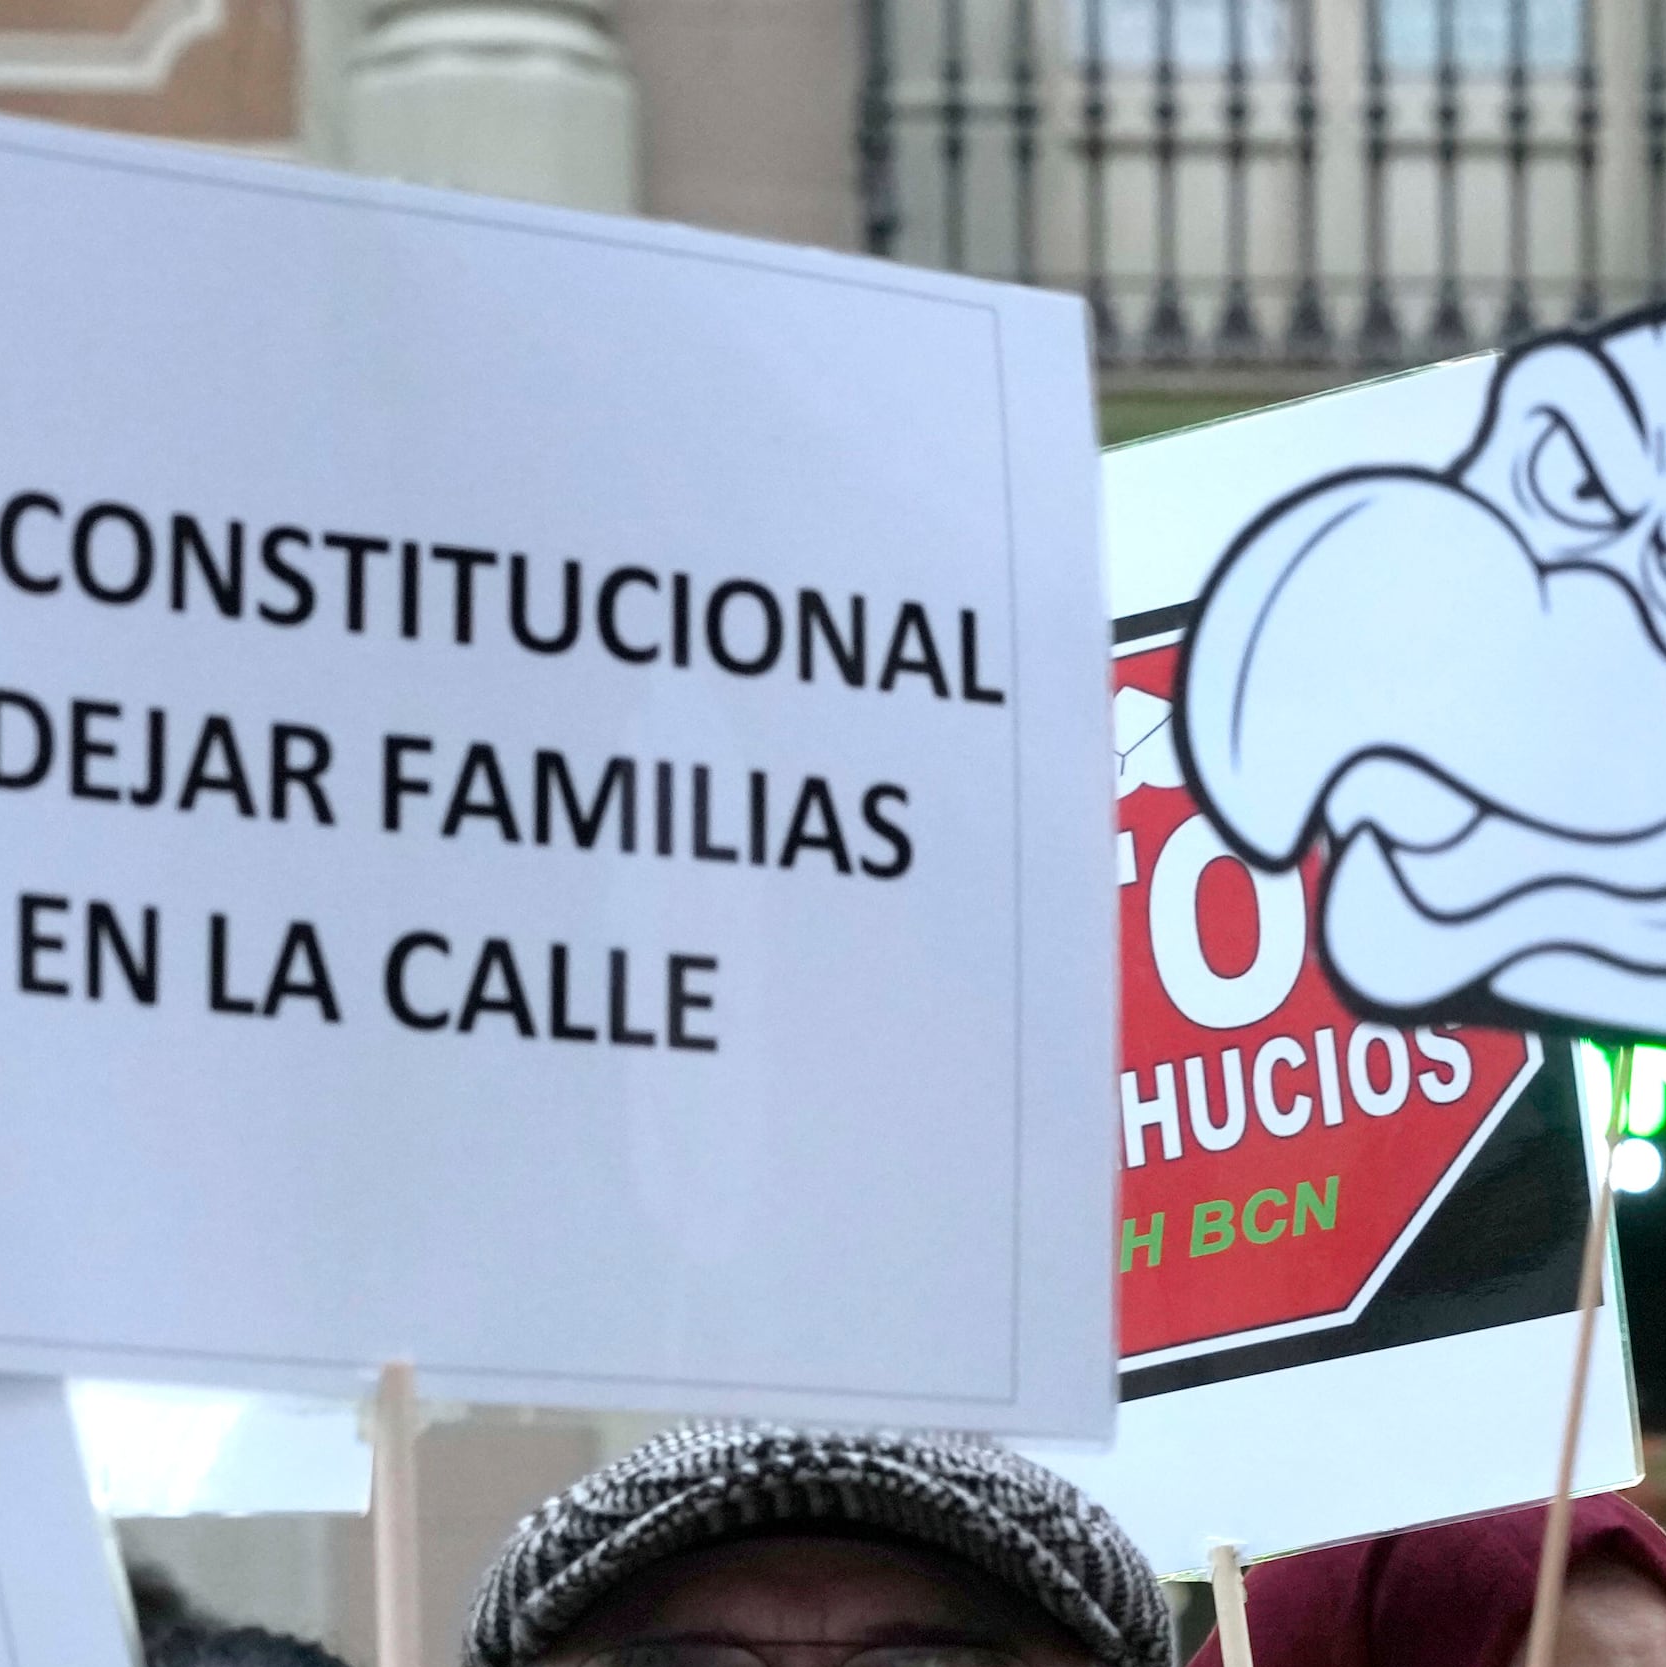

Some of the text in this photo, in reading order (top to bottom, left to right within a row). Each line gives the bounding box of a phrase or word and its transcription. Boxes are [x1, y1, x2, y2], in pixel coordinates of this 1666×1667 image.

[382, 733, 913, 880] FAMILIAS
[18, 892, 718, 1052] EN LA CALLE
[1117, 812, 1307, 1030] O
[1118, 1017, 1473, 1169] HUCIOS
[1189, 1175, 1340, 1258] BCN
